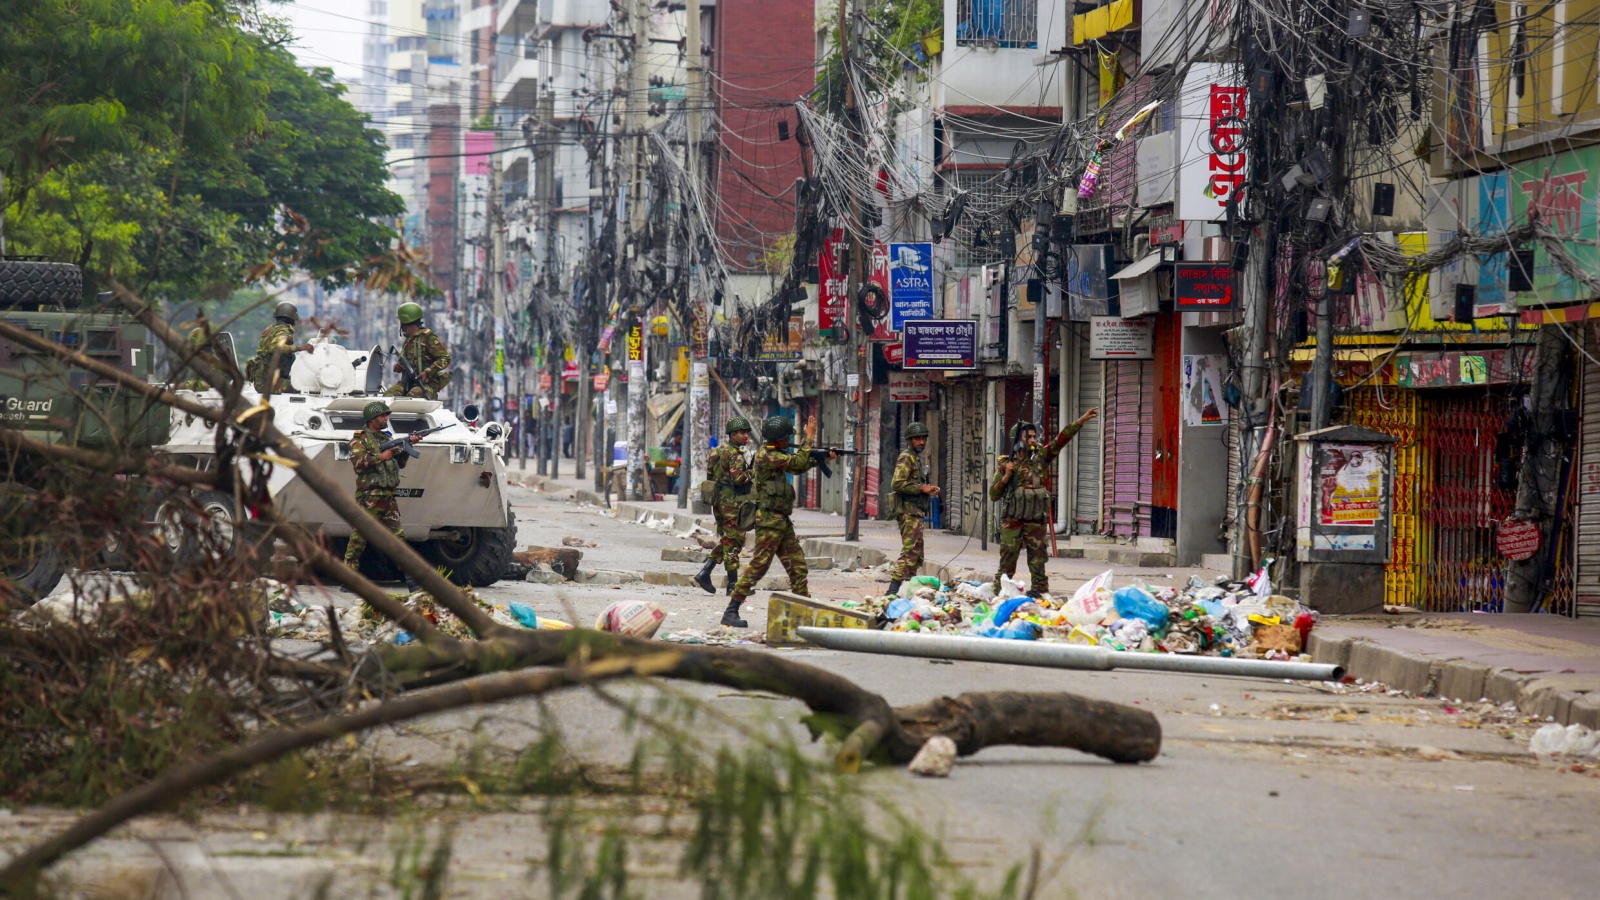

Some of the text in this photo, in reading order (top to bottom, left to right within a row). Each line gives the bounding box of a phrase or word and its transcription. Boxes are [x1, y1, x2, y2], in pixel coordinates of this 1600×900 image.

[895, 278, 930, 288] ASTRA
[895, 300, 930, 308] আল-আমিন
[918, 326, 944, 335] আজহারুল
[945, 326, 955, 335] হক
[956, 324, 973, 337] চৌধুরী
[6, 397, 53, 411] Guard
